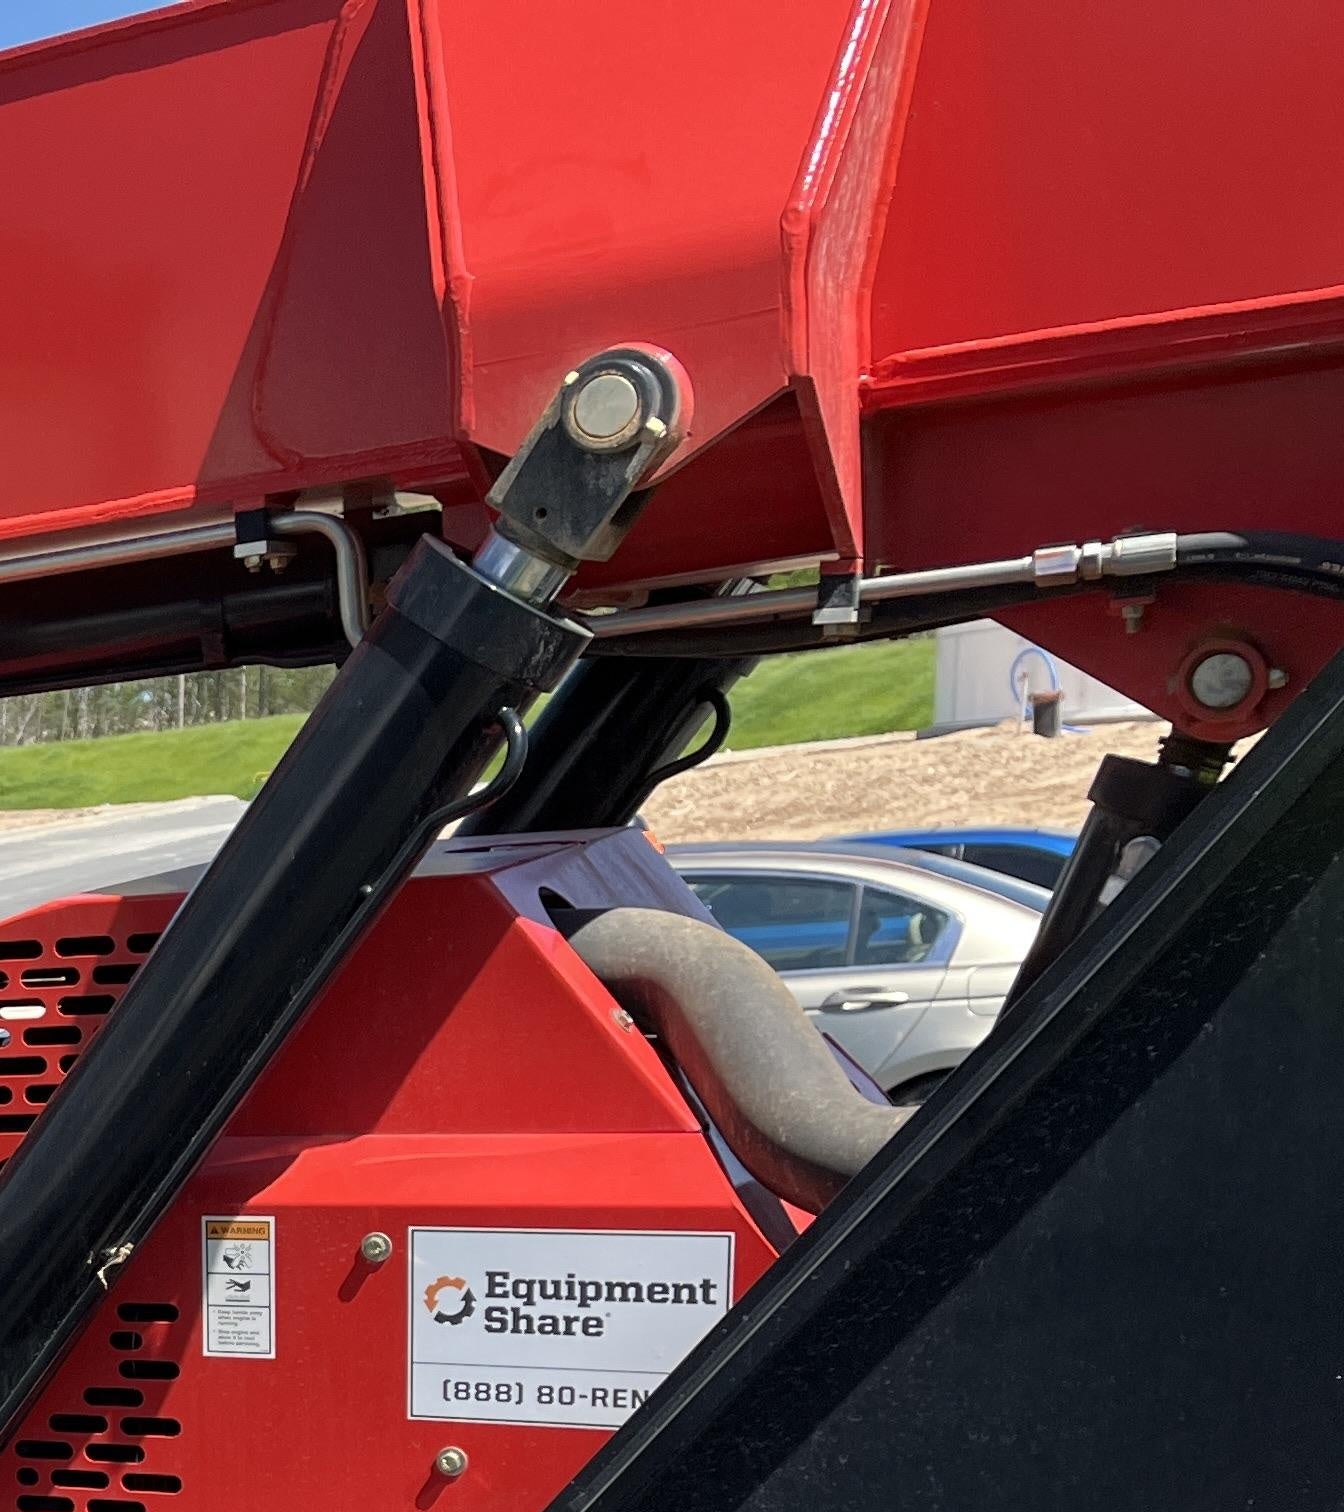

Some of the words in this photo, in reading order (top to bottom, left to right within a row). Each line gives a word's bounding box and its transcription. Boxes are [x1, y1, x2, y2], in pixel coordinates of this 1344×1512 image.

[220, 1226, 266, 1235] WARNING
[484, 1270, 718, 1308] Equipment
[484, 1306, 604, 1337] Share
[442, 1378, 524, 1405] (888)
[536, 1385, 650, 1410] 80-REN
